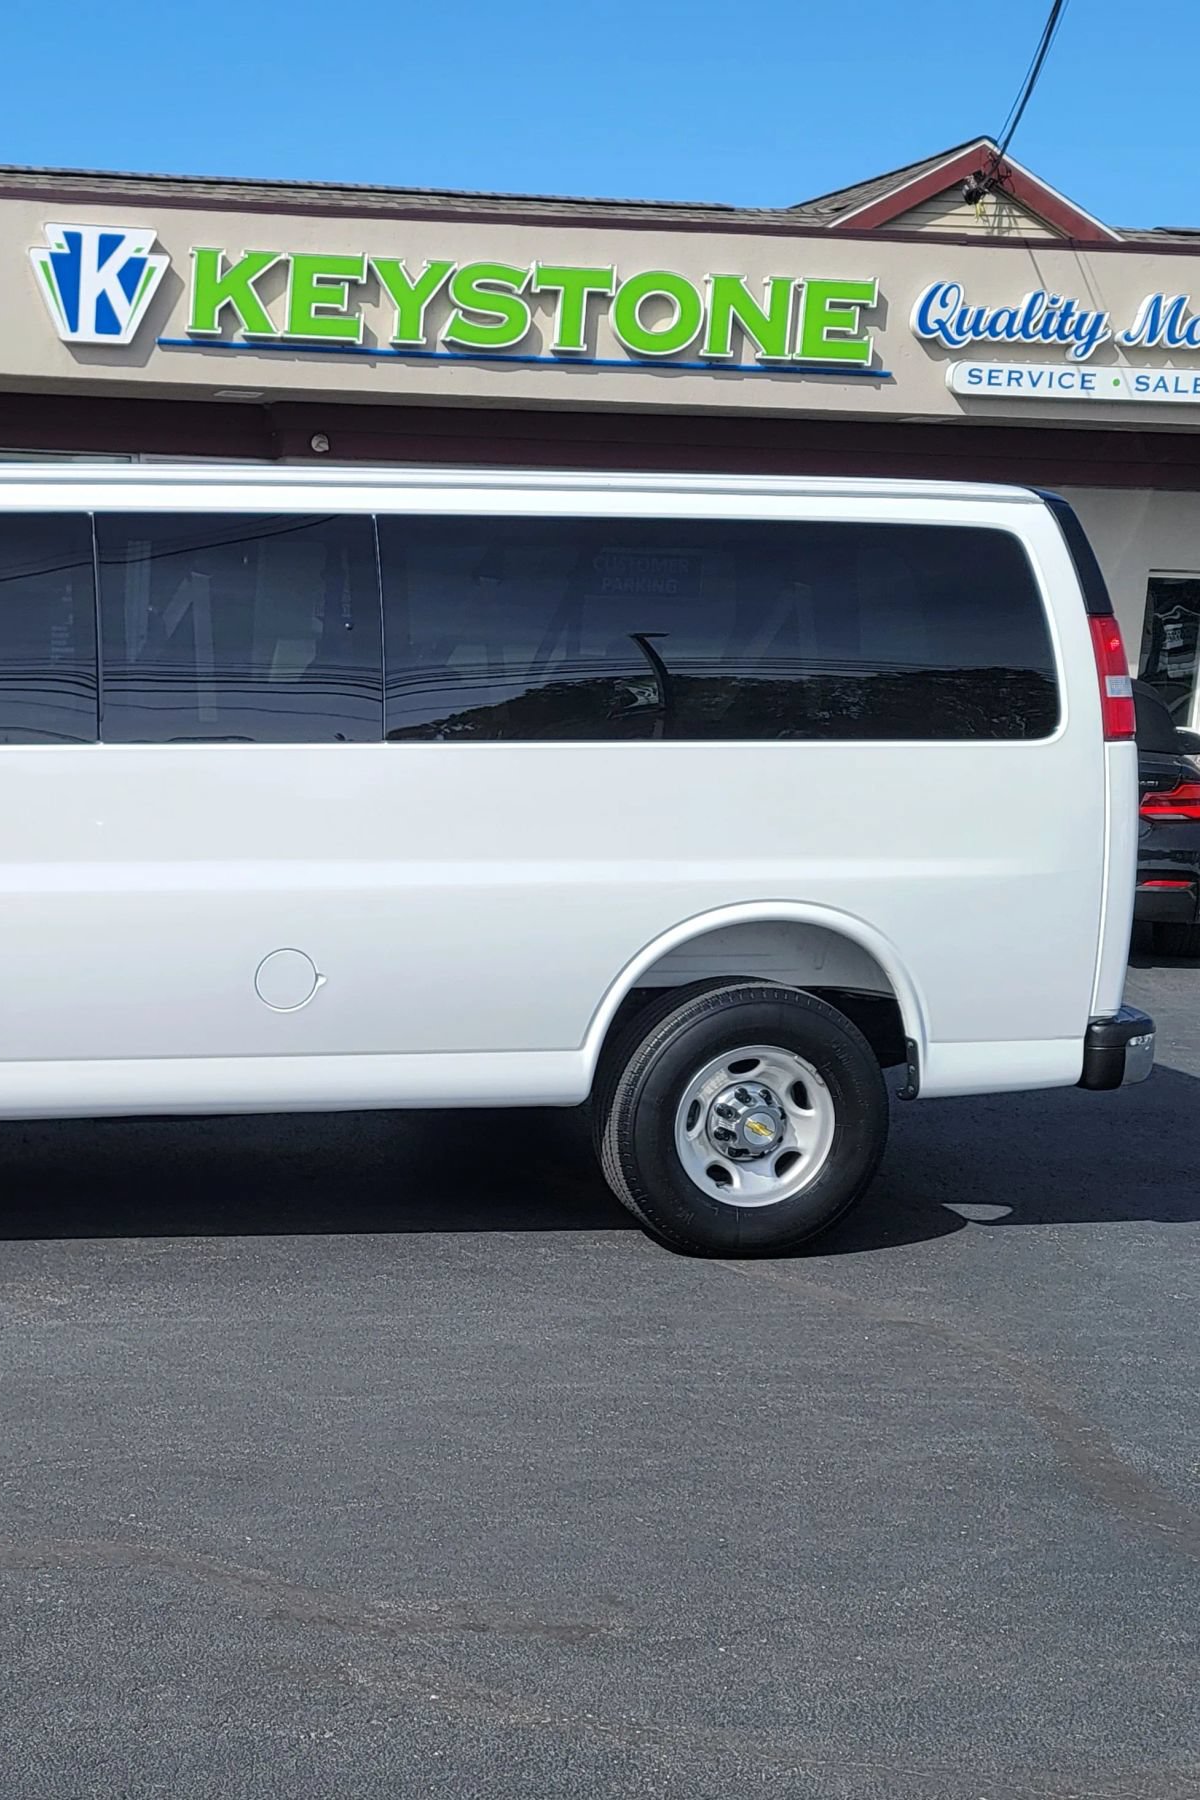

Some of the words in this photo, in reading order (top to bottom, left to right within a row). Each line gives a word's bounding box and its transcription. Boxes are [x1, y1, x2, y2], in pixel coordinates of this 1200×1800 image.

[187, 247, 879, 366] KEYSTONE
[912, 281, 1110, 361] Quality
[967, 367, 1097, 391] SERVICE
[592, 555, 689, 574] CUSTOMER
[601, 576, 680, 593] PARKING
